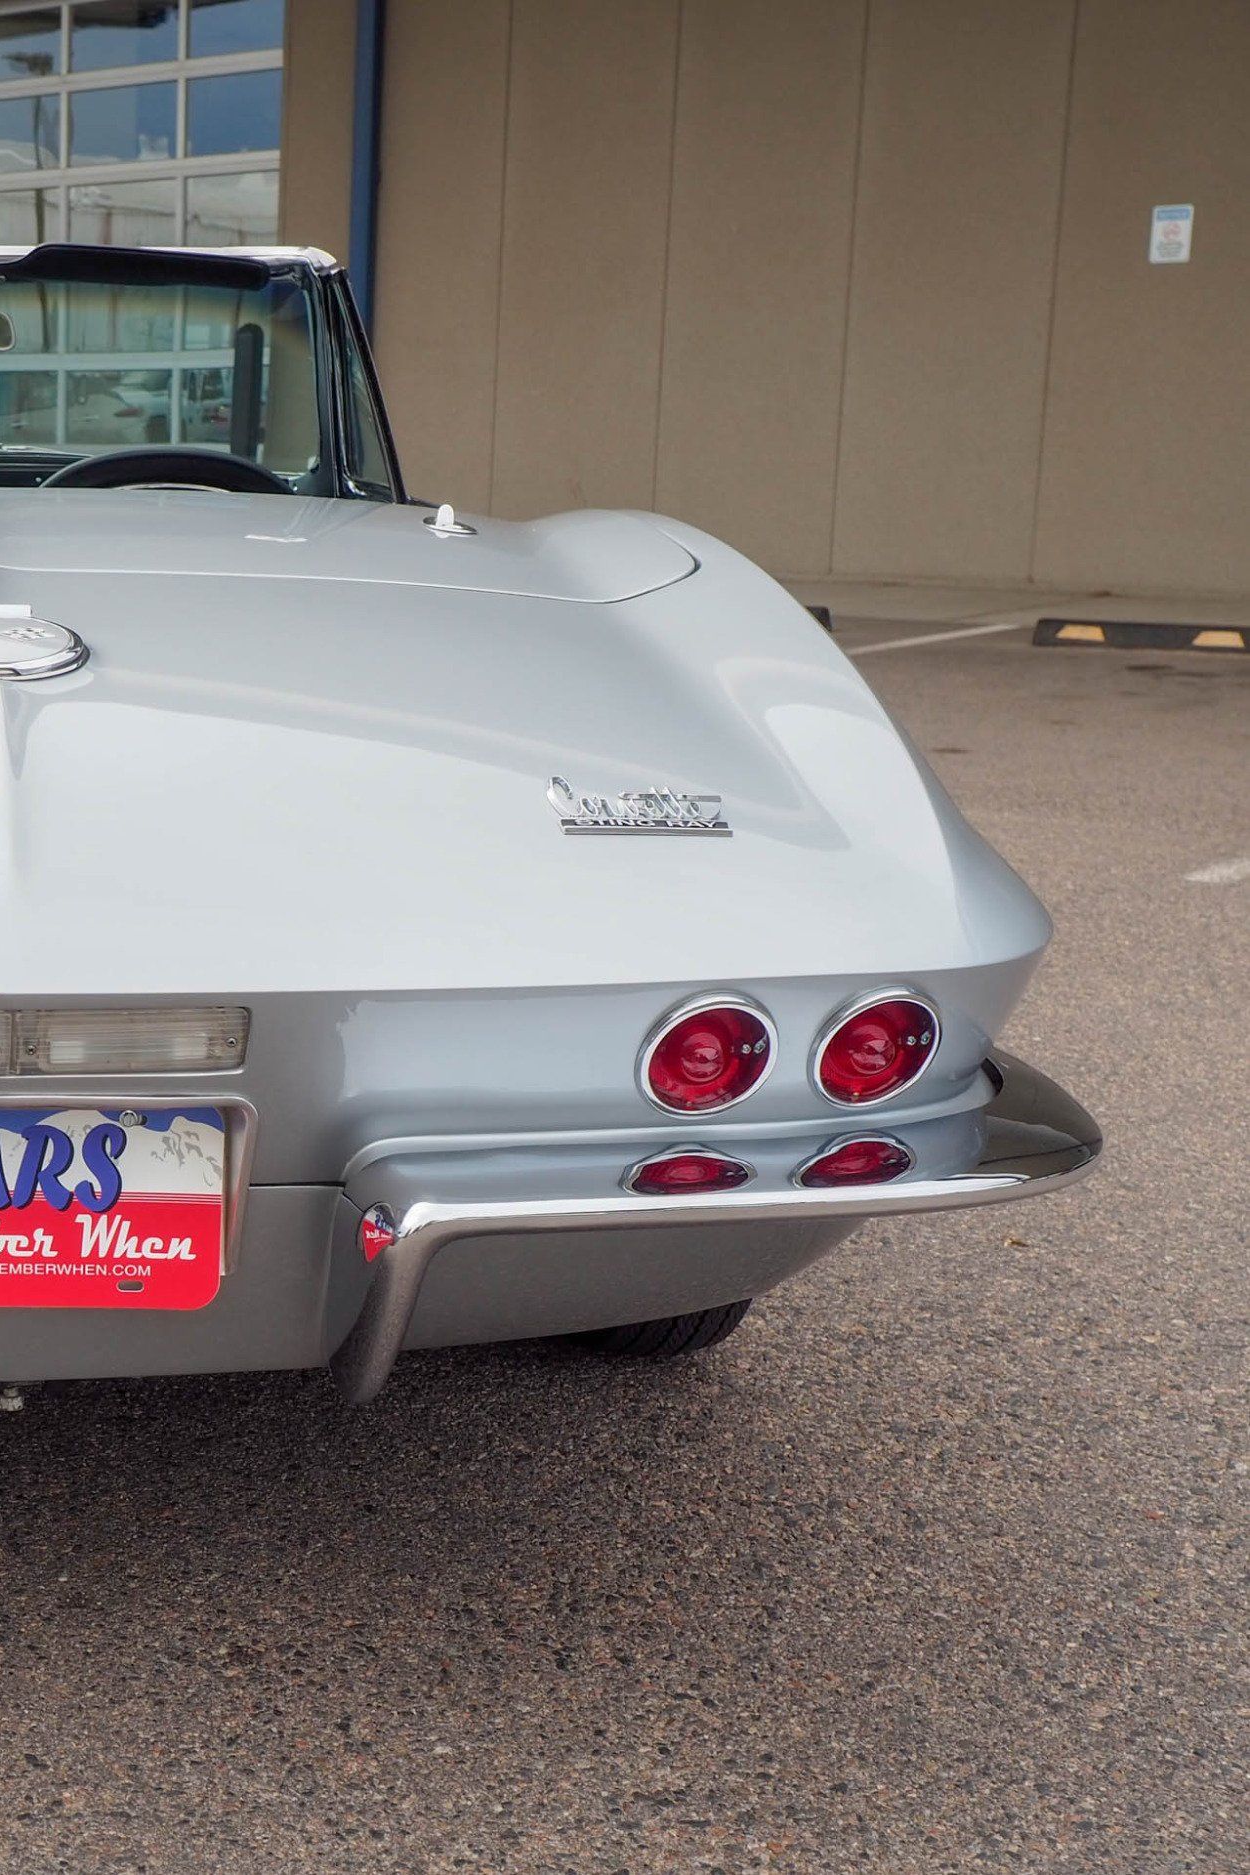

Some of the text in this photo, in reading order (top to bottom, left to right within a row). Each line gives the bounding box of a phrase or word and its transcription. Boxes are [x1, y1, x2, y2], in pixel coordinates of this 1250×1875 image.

[547, 775, 722, 820] Corvette
[574, 818, 717, 829] STING RAY
[74, 1213, 197, 1261] When
